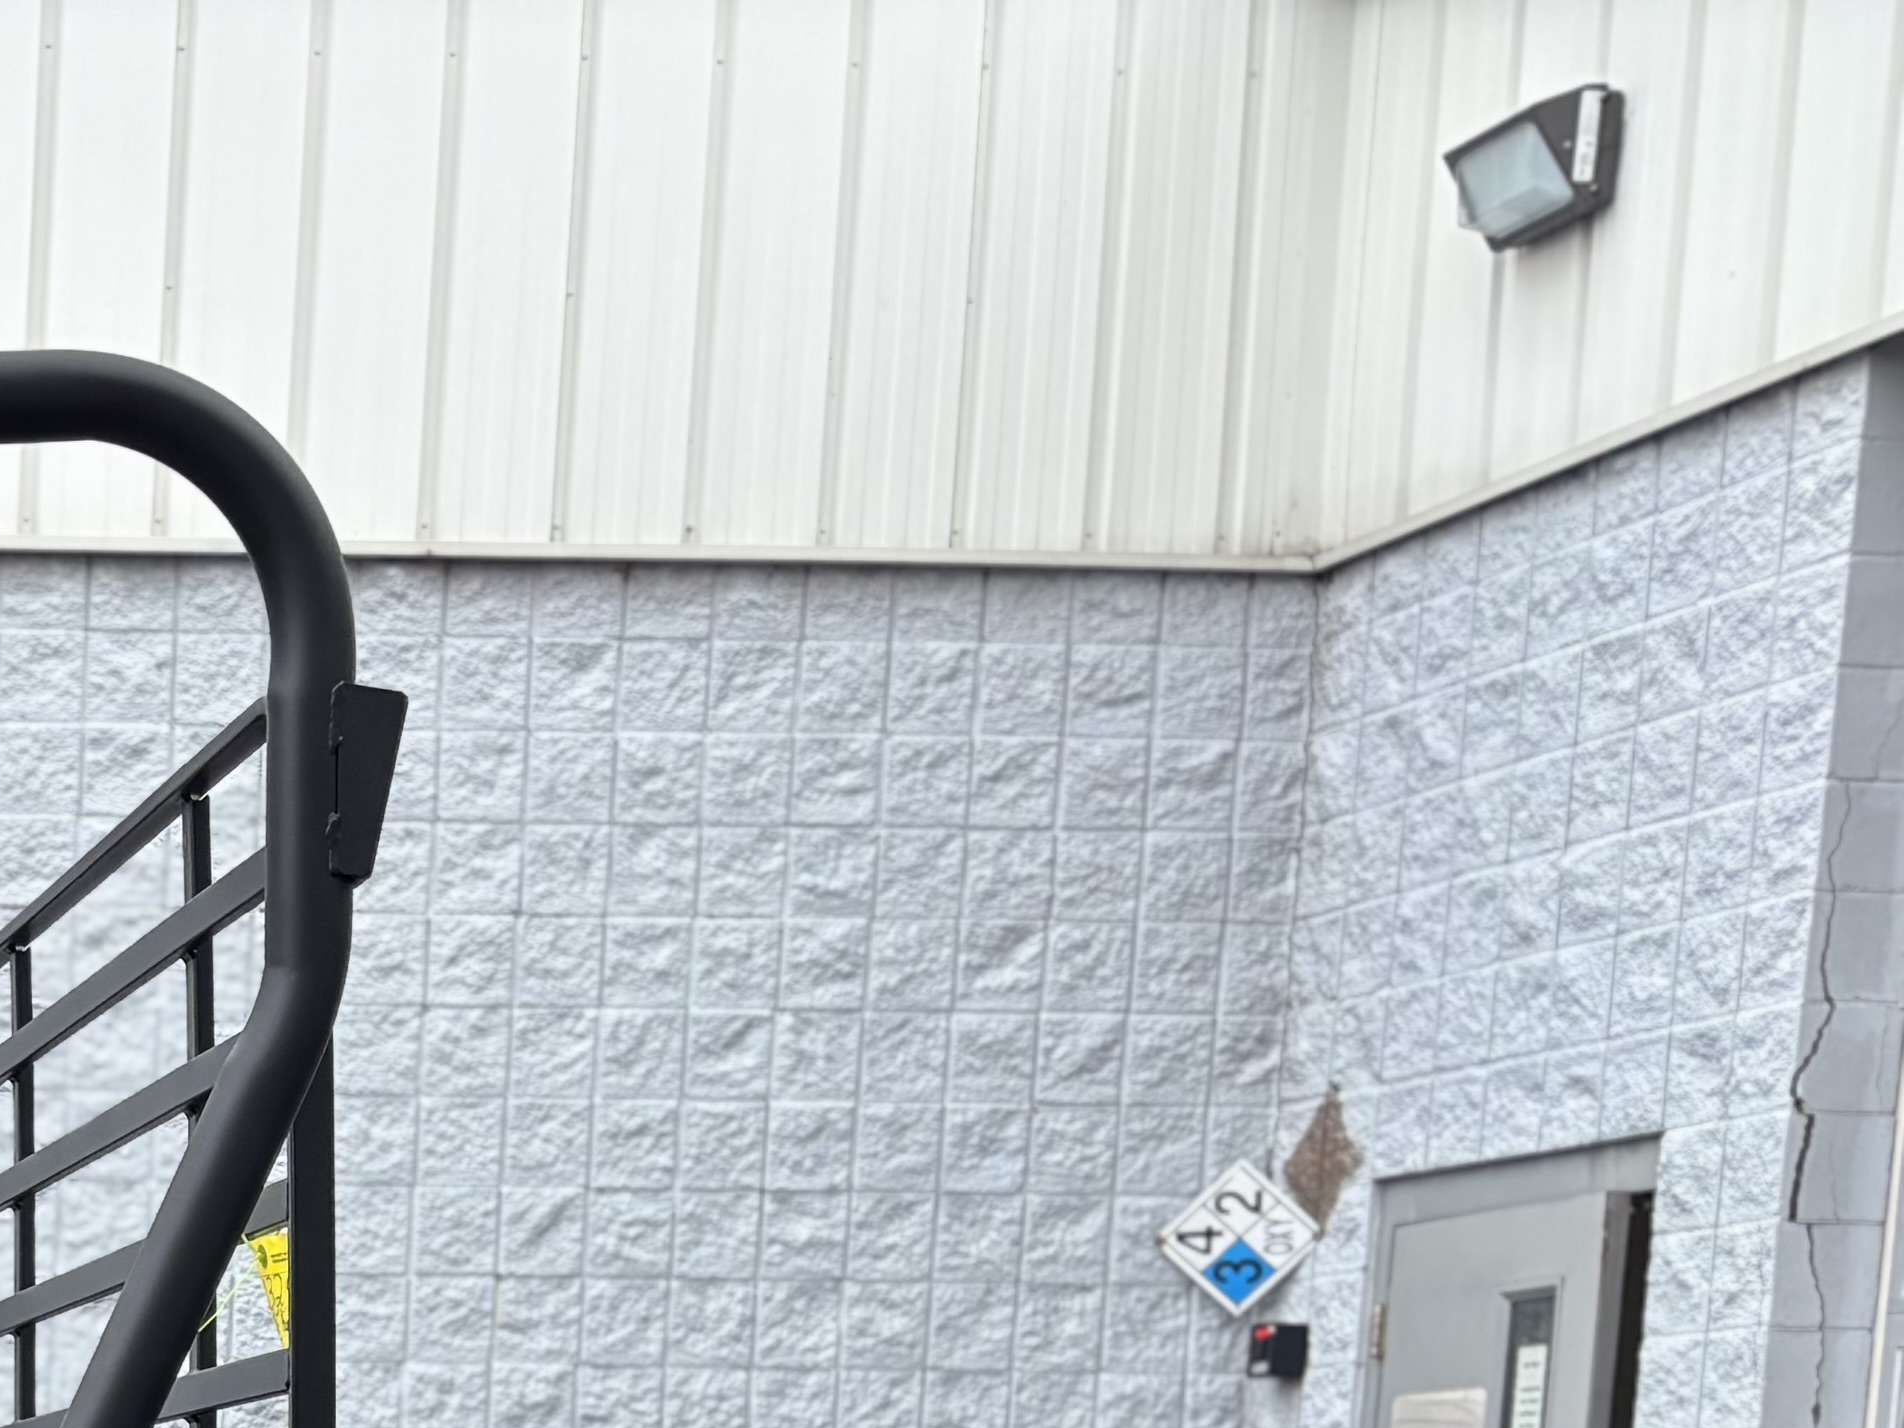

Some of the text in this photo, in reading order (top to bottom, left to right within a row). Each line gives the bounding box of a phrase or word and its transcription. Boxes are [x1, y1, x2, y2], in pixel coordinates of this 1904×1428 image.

[1214, 1190, 1262, 1215] 2
[1176, 1225, 1223, 1255] 4
[1264, 1218, 1294, 1256] OXY
[1213, 1259, 1263, 1285] 3
